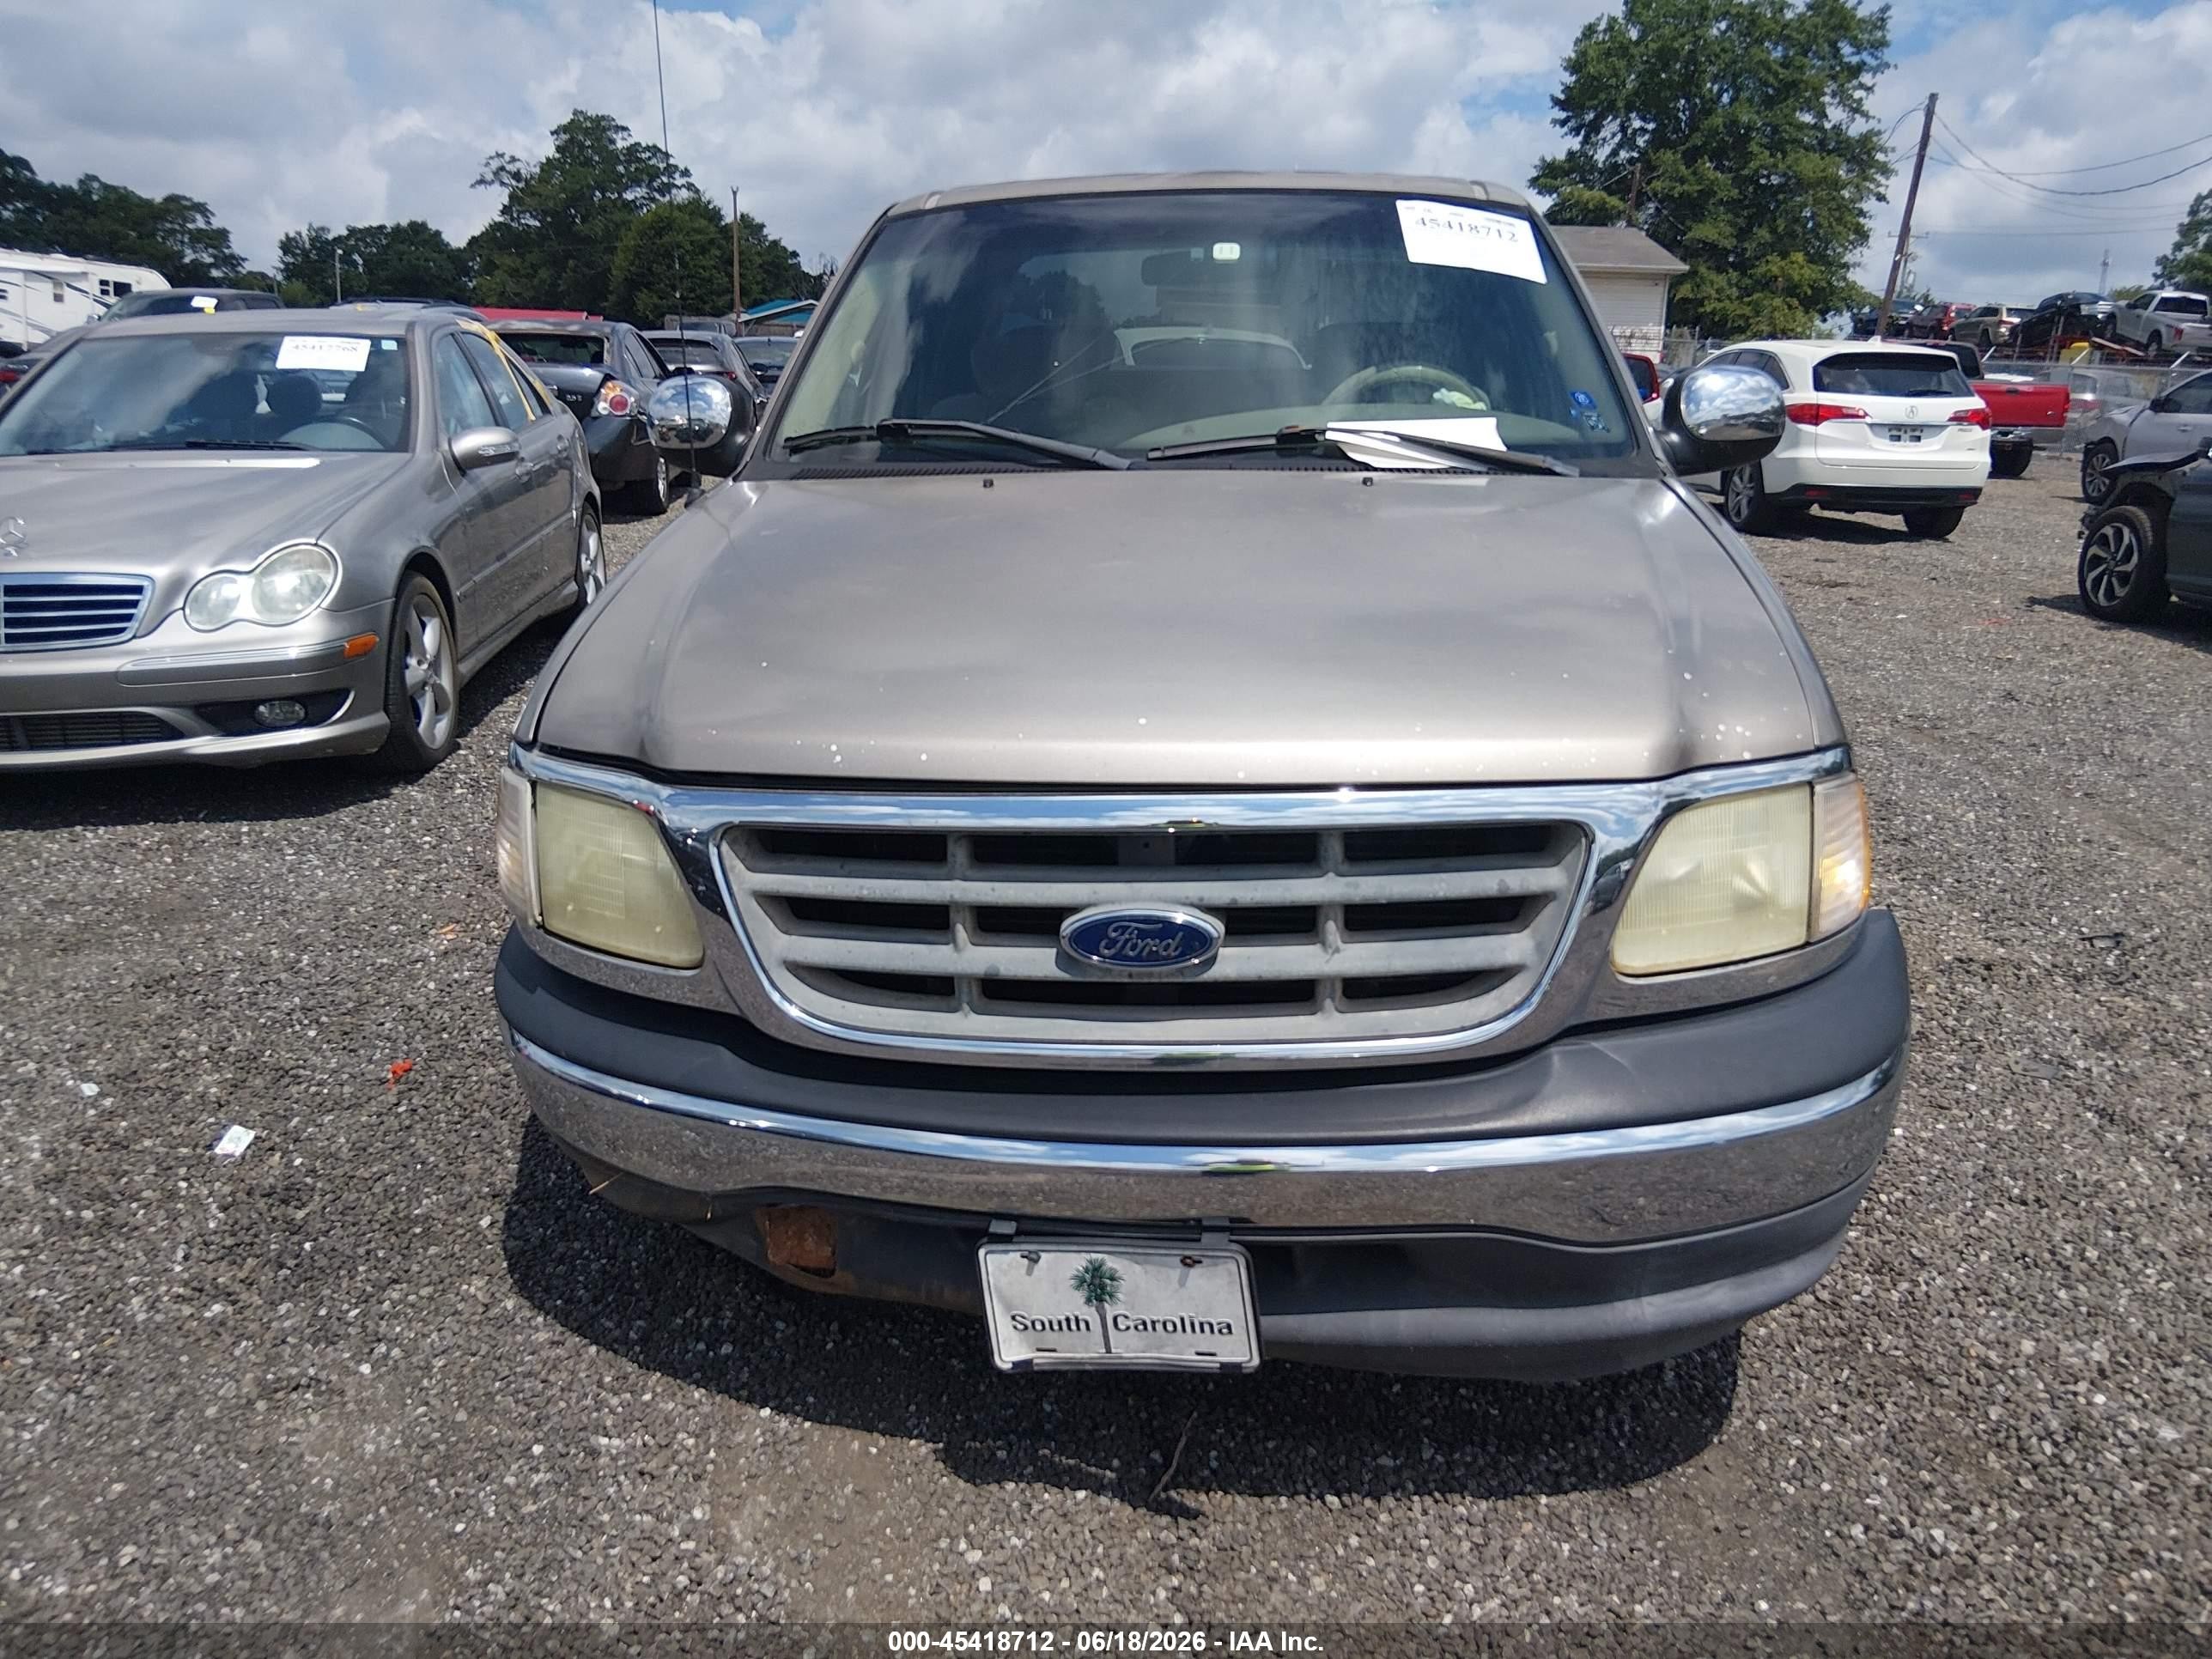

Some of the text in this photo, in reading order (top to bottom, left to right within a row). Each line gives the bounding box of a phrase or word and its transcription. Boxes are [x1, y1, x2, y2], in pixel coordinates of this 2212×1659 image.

[1415, 216, 1519, 243] 45418712
[1098, 921, 1184, 957] Ford
[1010, 1310, 1235, 1336] South Carolina
